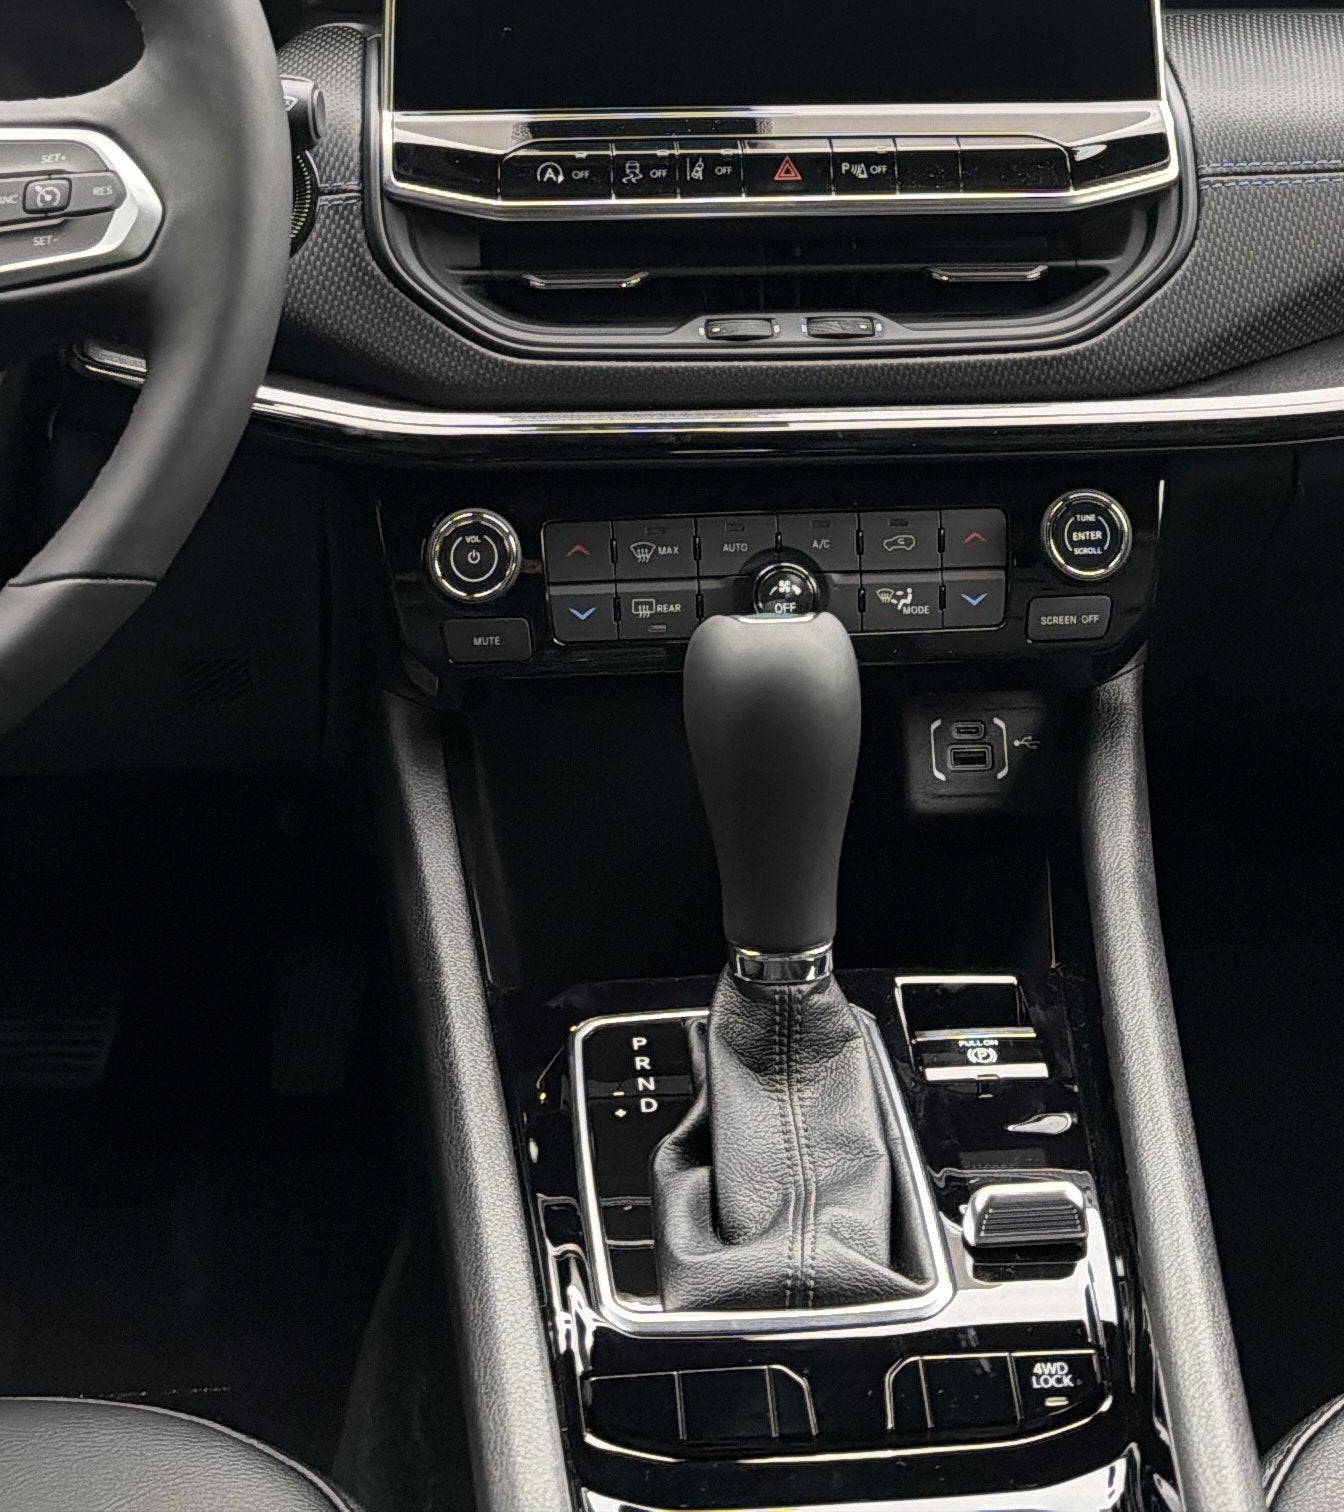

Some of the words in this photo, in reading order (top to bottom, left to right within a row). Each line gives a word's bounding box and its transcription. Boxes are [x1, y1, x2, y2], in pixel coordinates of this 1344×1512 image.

[649, 168, 668, 179] OFF
[714, 165, 733, 176] OFF
[869, 163, 888, 174] OFF
[571, 169, 590, 180] OFF
[92, 185, 113, 196] RES
[1075, 513, 1096, 522] TUNE
[465, 534, 482, 544] VOL
[1072, 530, 1102, 541] ENTER
[722, 542, 748, 553] AUTO
[812, 538, 830, 549] A/C
[658, 545, 679, 555] MAX
[1073, 545, 1103, 555] SCROLL
[657, 603, 681, 614] REAR
[774, 602, 796, 614] OFF
[903, 604, 930, 615] MODE
[1040, 615, 1076, 625] SCREEN
[1081, 614, 1100, 625] OFF
[473, 635, 500, 646] MUTE
[632, 1037, 647, 1050] P
[635, 1056, 651, 1070] R
[637, 1077, 655, 1091] N
[640, 1098, 658, 1113] D
[1033, 1361, 1069, 1375] 4WD
[1031, 1374, 1074, 1388] LOCK
